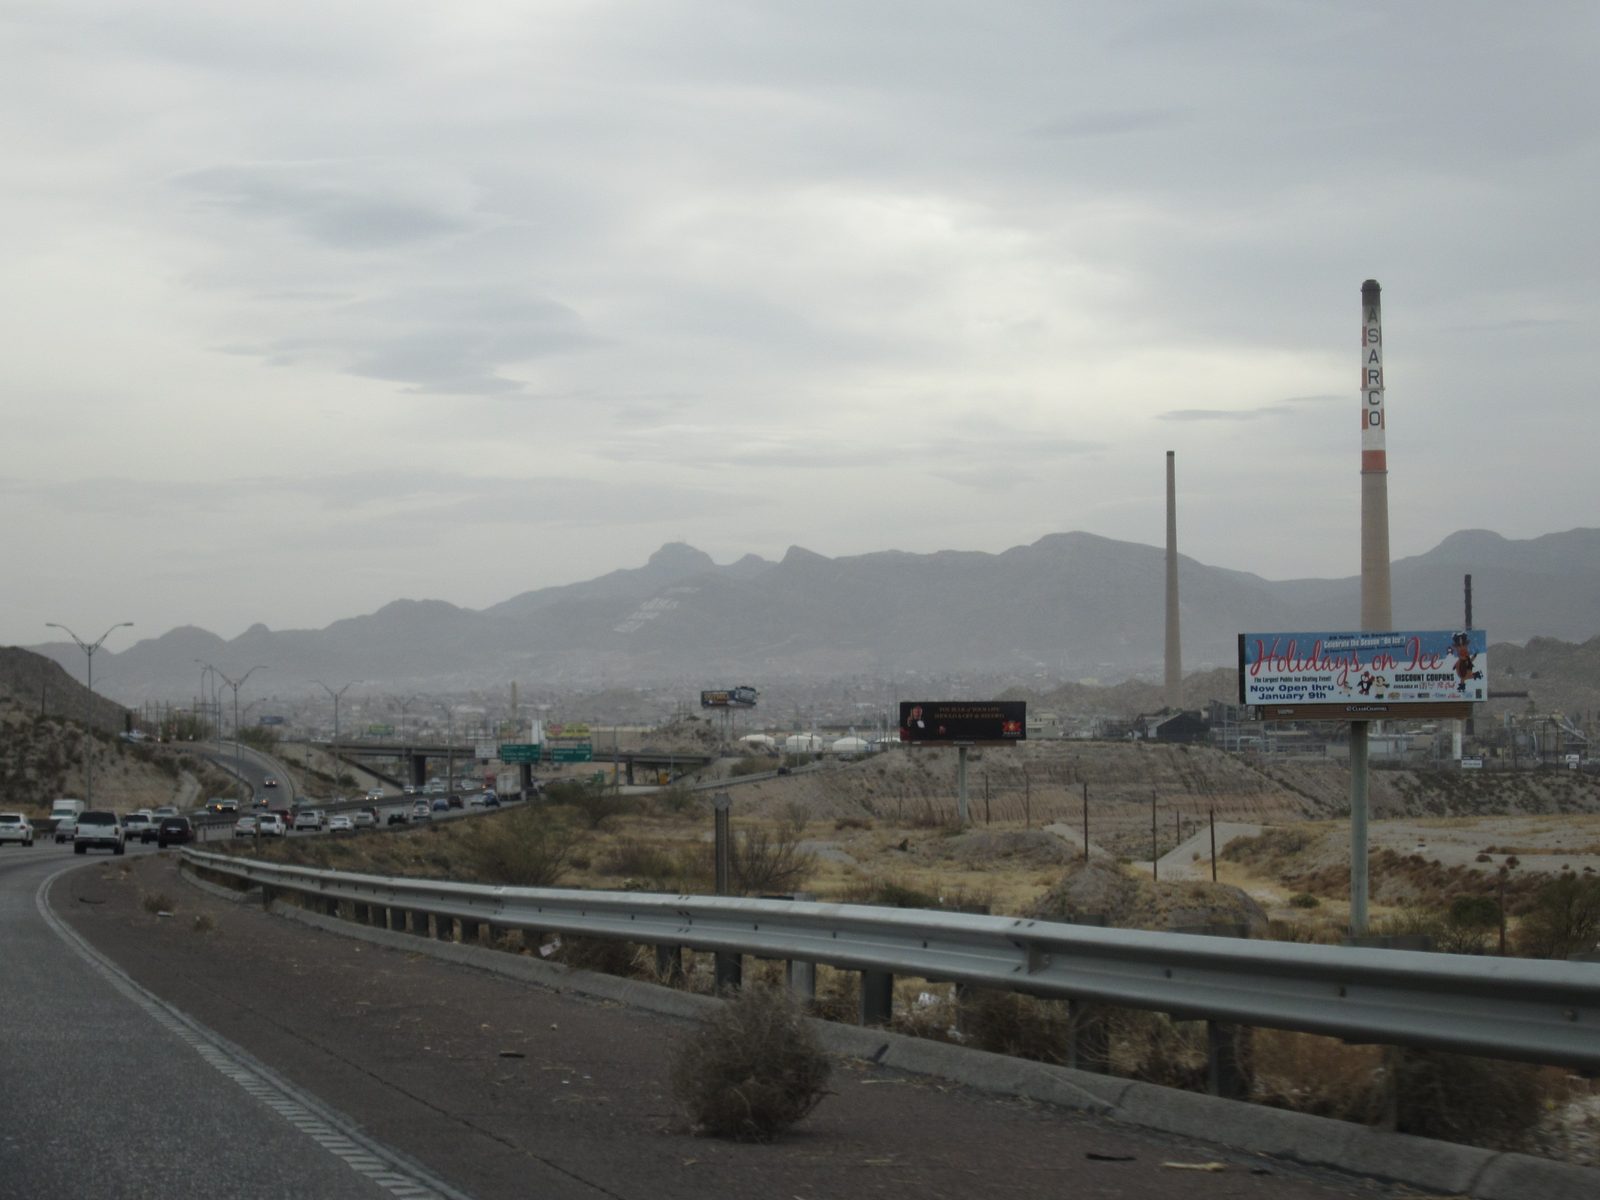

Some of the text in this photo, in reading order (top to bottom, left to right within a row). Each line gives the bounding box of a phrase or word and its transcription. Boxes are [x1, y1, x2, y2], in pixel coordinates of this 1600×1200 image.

[1367, 307, 1380, 426] ASARCO
[1250, 636, 1443, 687] Holidays on Ice
[1394, 673, 1455, 682] DISCOUNT COUPONS
[1279, 684, 1308, 693] Open
[1312, 683, 1335, 691] thru
[1258, 691, 1327, 700] January 9th
